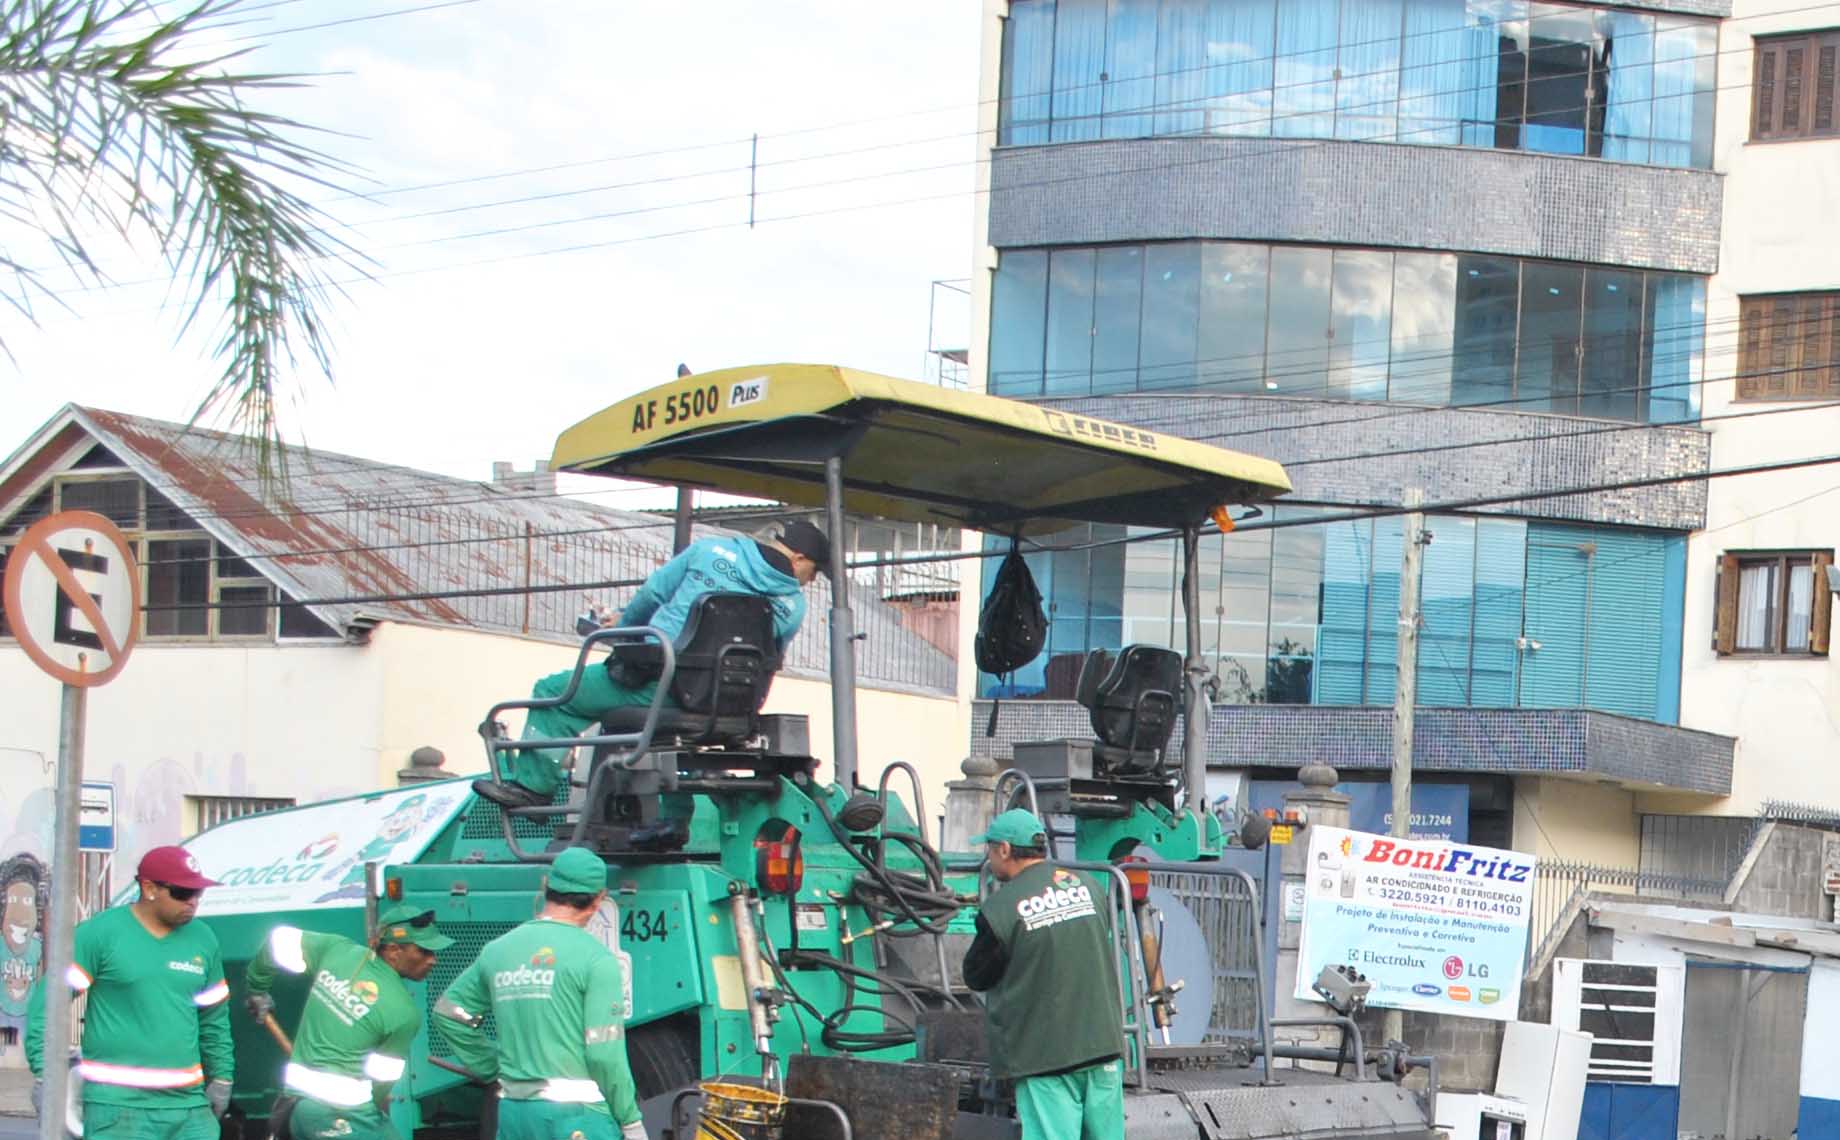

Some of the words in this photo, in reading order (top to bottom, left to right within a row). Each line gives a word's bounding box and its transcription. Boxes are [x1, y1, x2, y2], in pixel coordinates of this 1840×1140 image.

[632, 400, 656, 433] AF
[665, 385, 719, 425] 5500
[1409, 813, 1452, 827] 021.7244
[1363, 839, 1531, 883] BoniFritz
[1365, 876, 1380, 884] AR
[1017, 885, 1092, 917] codeca
[1379, 888, 1445, 905] 3220.5921
[1456, 898, 1522, 916] 8110.4103
[621, 910, 668, 943] 434
[1336, 904, 1373, 919] Projeto
[1375, 909, 1388, 919] de
[1451, 918, 1511, 934] Manutenção
[1367, 923, 1420, 937] Preventiva
[1431, 930, 1476, 944] Corretiva
[494, 963, 555, 988] codeca
[1363, 950, 1426, 969] Electrolux
[1467, 963, 1490, 978] LG
[318, 969, 370, 1018] codeca
